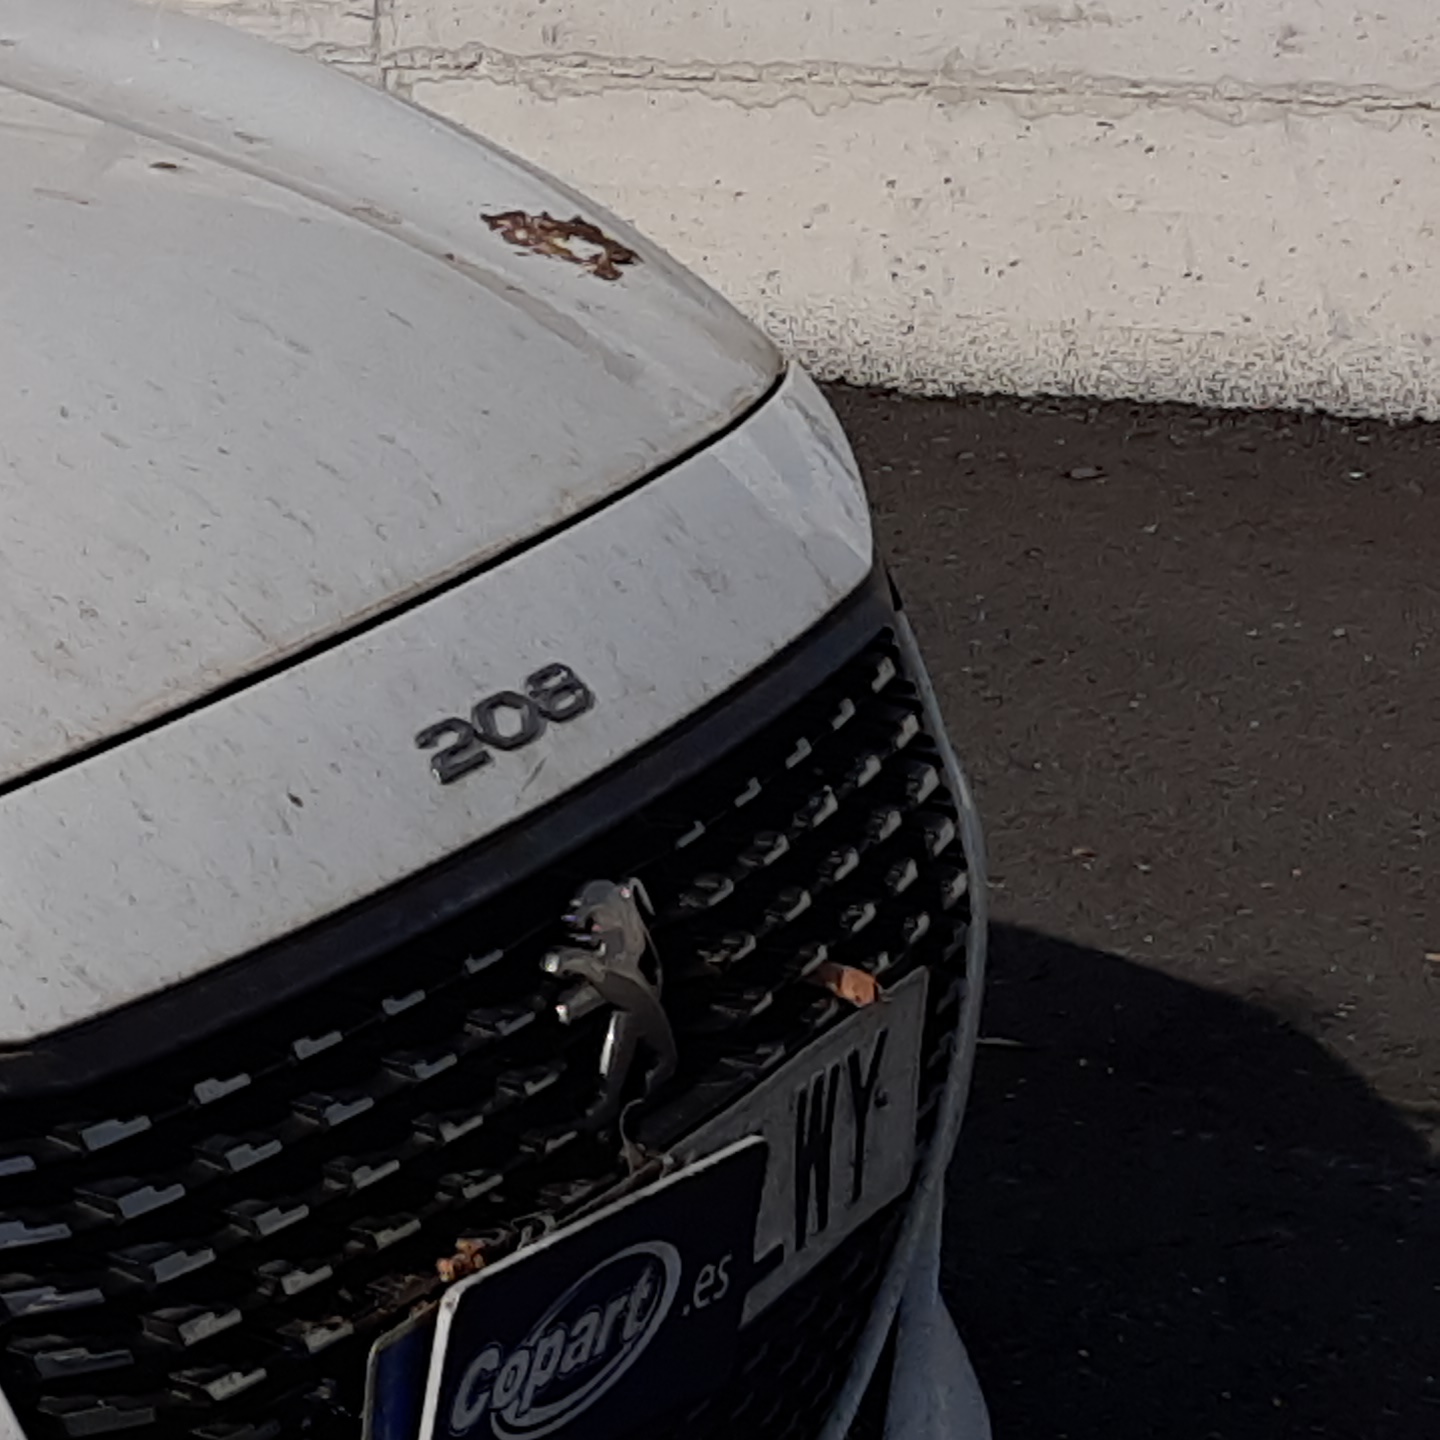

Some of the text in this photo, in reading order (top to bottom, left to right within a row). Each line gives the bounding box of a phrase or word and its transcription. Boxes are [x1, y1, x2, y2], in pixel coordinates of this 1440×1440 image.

[413, 660, 597, 786] 208
[753, 1027, 889, 1265] WY
[450, 1262, 662, 1438] Copart
